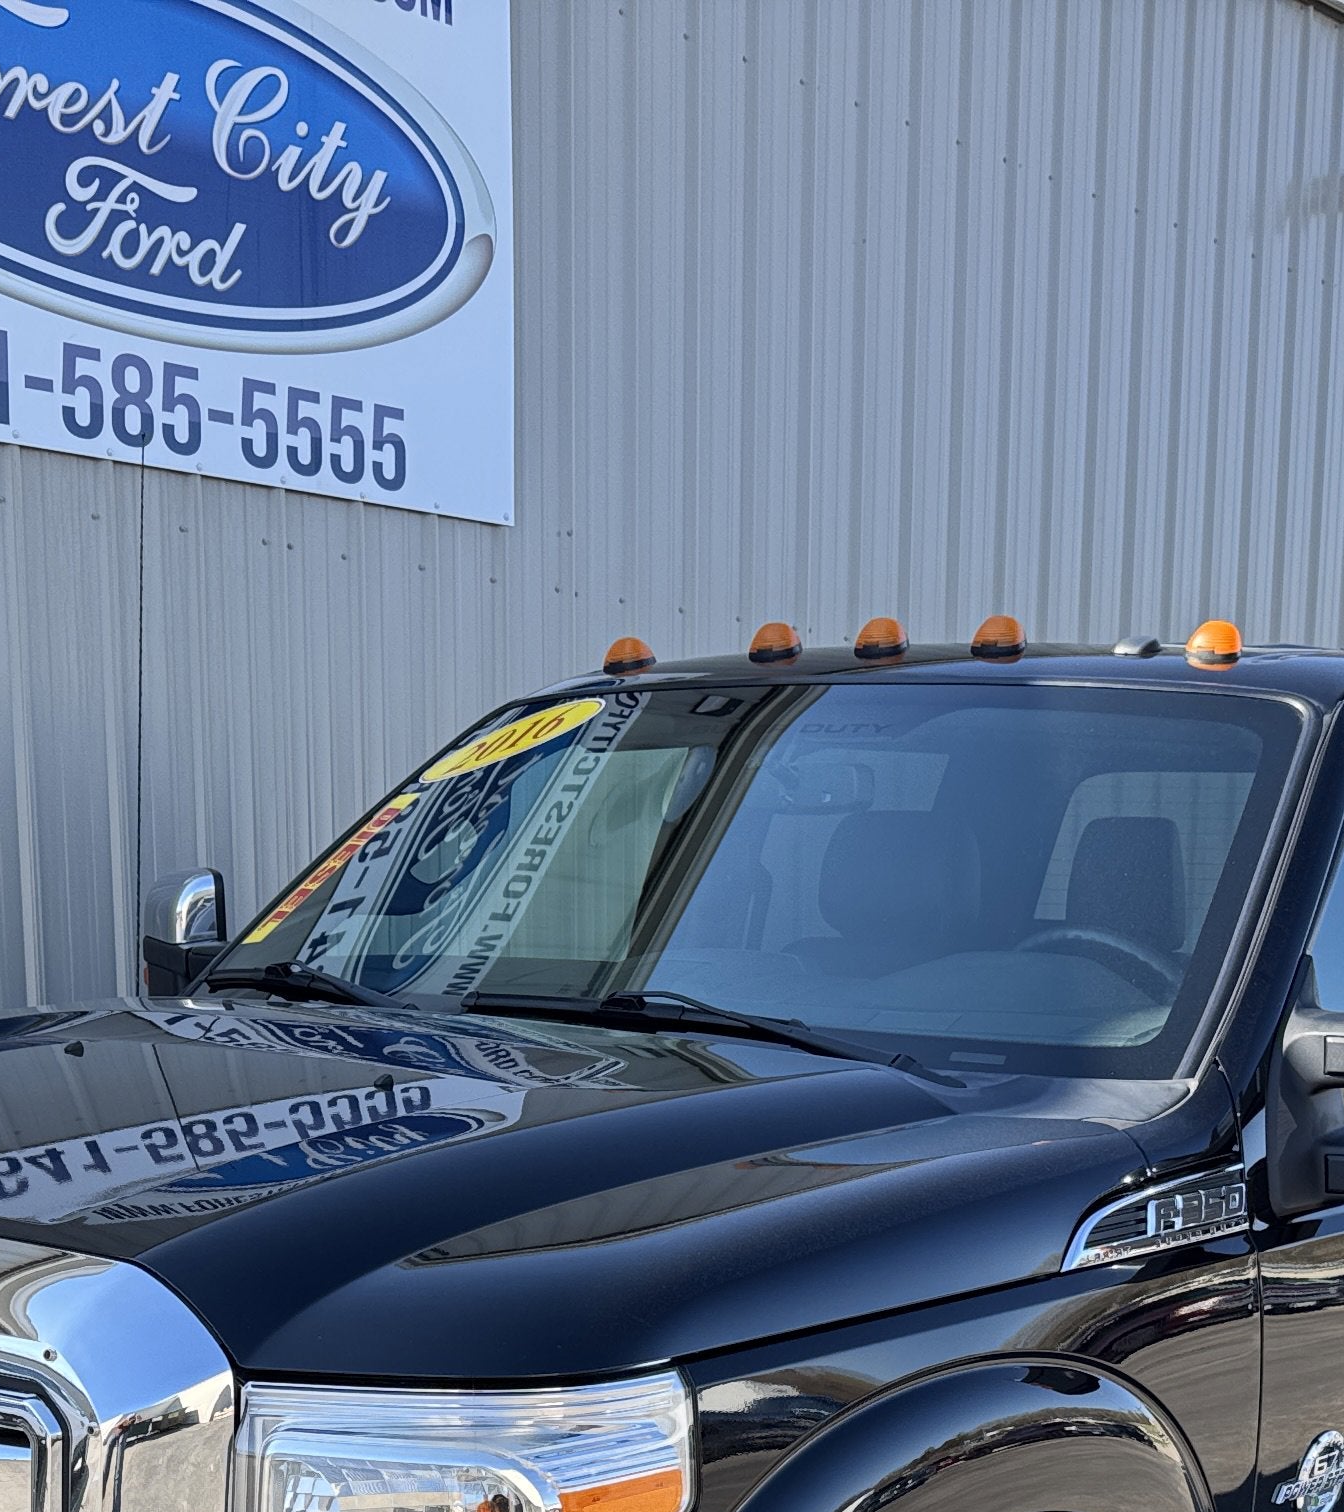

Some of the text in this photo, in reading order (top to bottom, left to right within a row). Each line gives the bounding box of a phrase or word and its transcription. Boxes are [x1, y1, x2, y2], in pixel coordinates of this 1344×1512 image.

[206, 58, 391, 249] City
[45, 156, 248, 292] Ford
[442, 704, 578, 776] 2016
[258, 807, 402, 932] DIESEL
